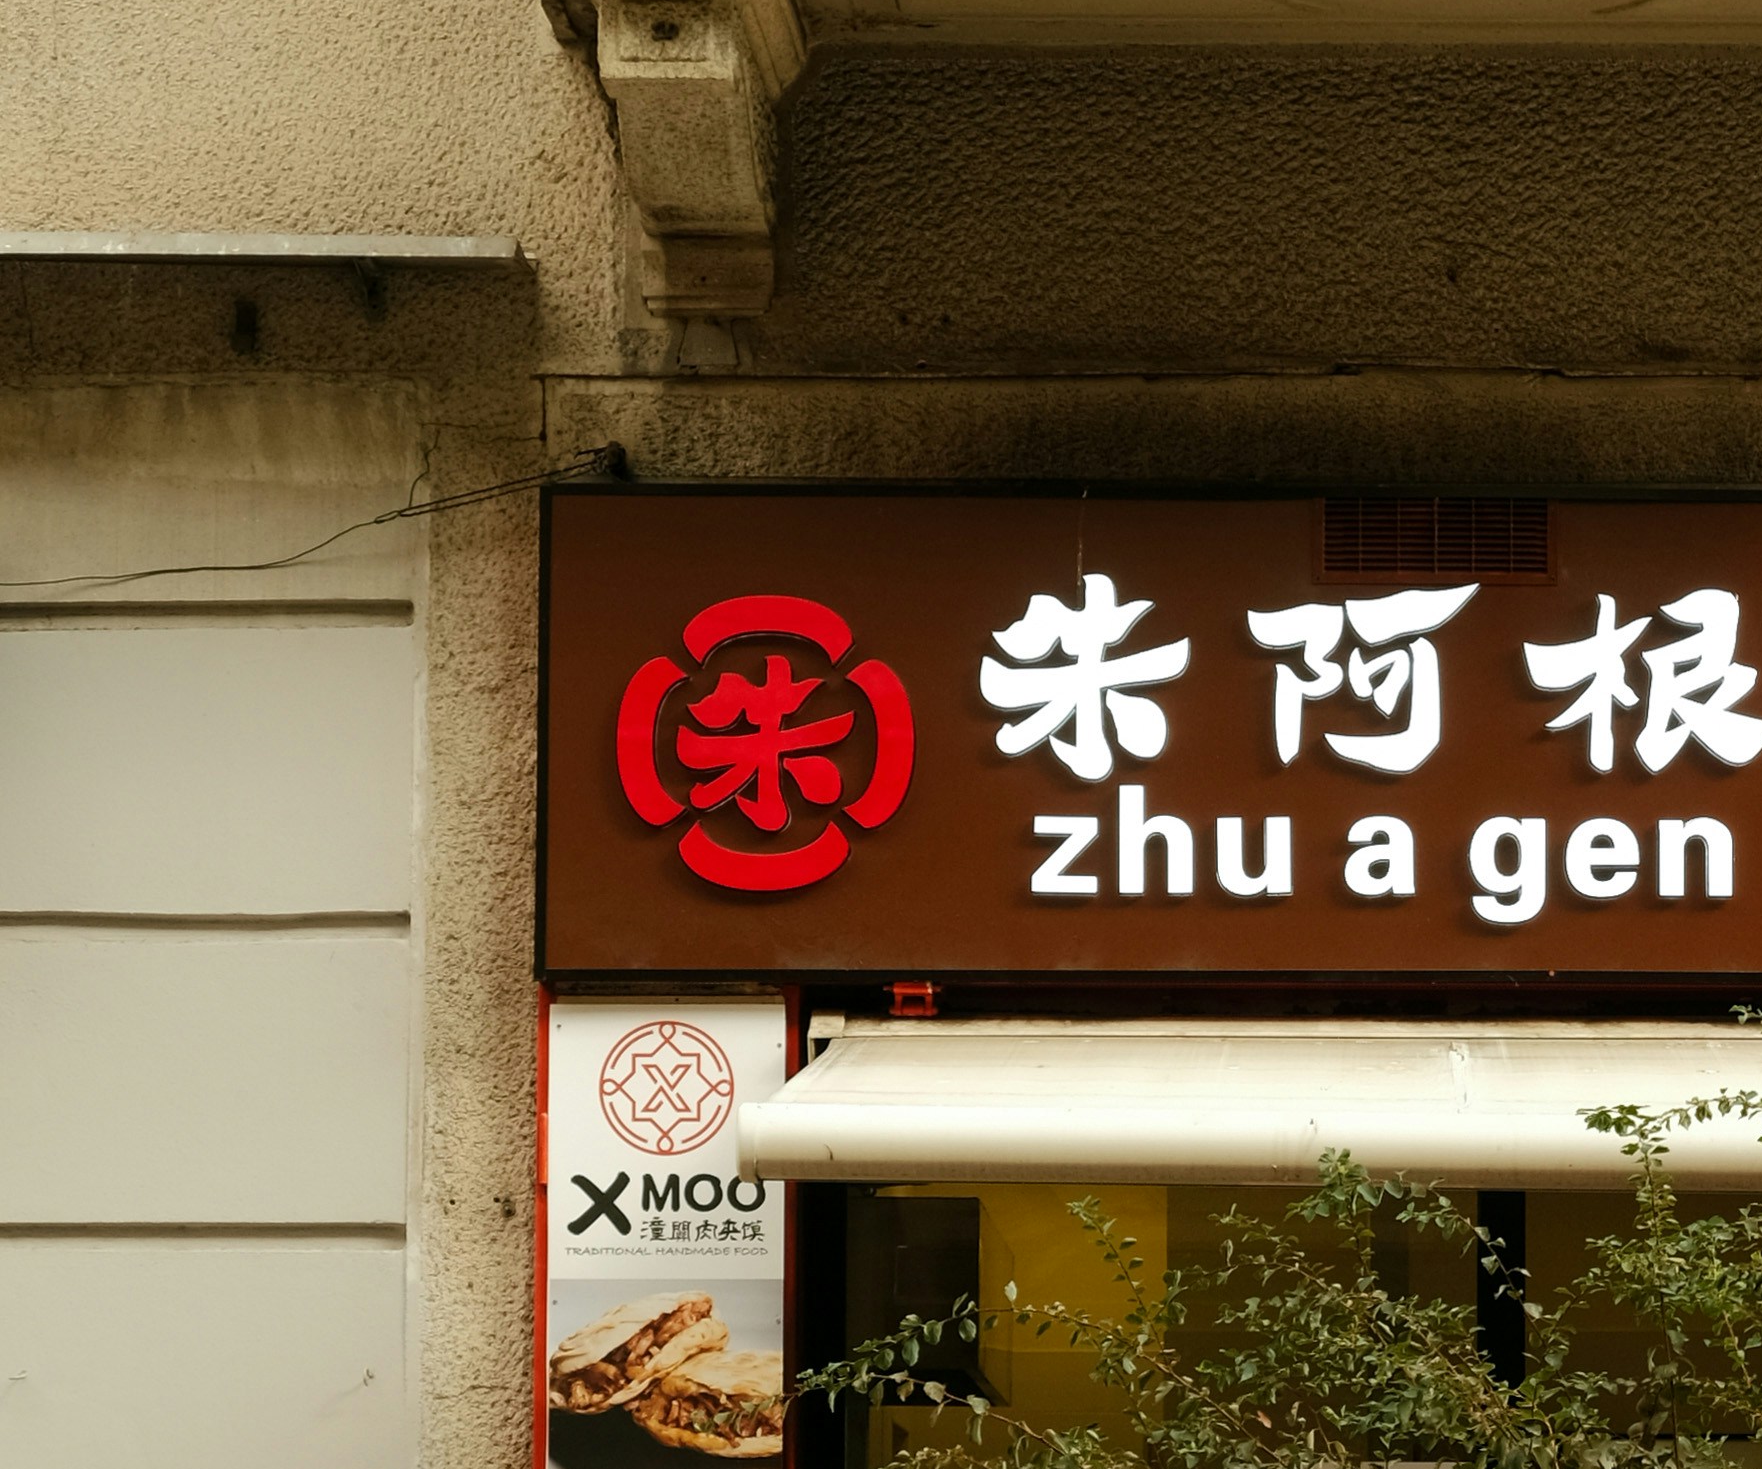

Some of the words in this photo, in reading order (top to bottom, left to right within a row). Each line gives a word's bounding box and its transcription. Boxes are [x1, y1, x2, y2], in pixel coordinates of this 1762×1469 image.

[676, 655, 854, 831] 朱
[1031, 784, 1292, 897] zhu
[1344, 815, 1416, 896] a
[1469, 816, 1733, 923] gen
[565, 1246, 651, 1256] TRADITIONAL
[656, 1246, 729, 1256] HANDMADE
[734, 1246, 768, 1256] FOOD
